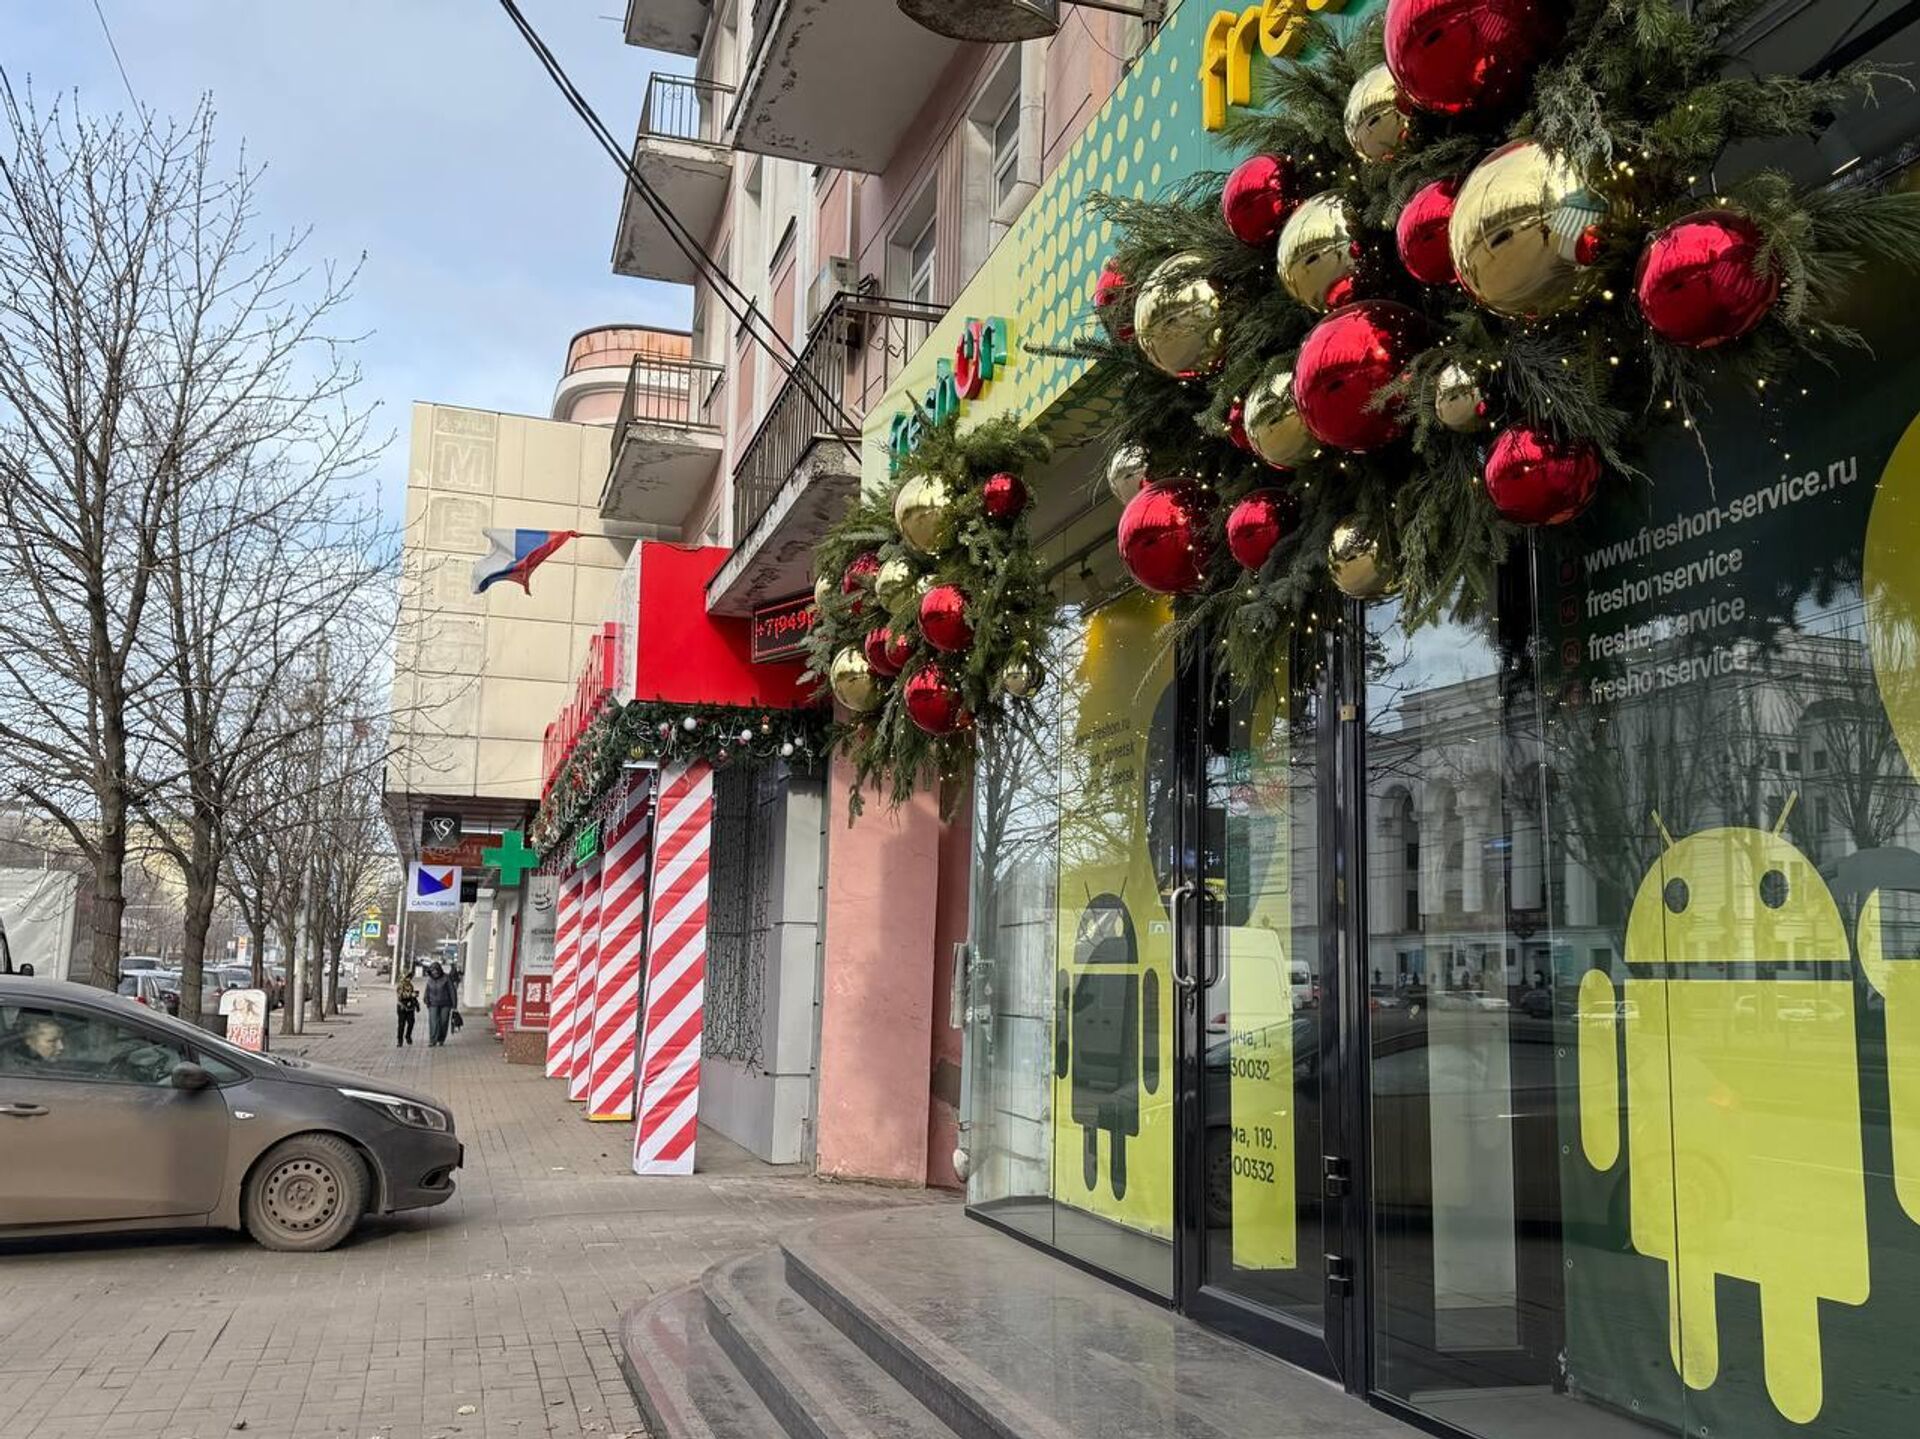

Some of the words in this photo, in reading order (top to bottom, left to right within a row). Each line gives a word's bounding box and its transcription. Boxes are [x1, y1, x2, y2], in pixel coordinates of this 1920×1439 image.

[1583, 456, 1858, 576] www.freshon-service.ru
[1585, 548, 1744, 619] freshonservice
[1587, 594, 1746, 662] freshonservice
[1590, 644, 1749, 706] freshonservice
[1231, 1057, 1270, 1081] 30032
[1254, 1126, 1277, 1150] 119.
[1233, 1155, 1274, 1184] 00332
